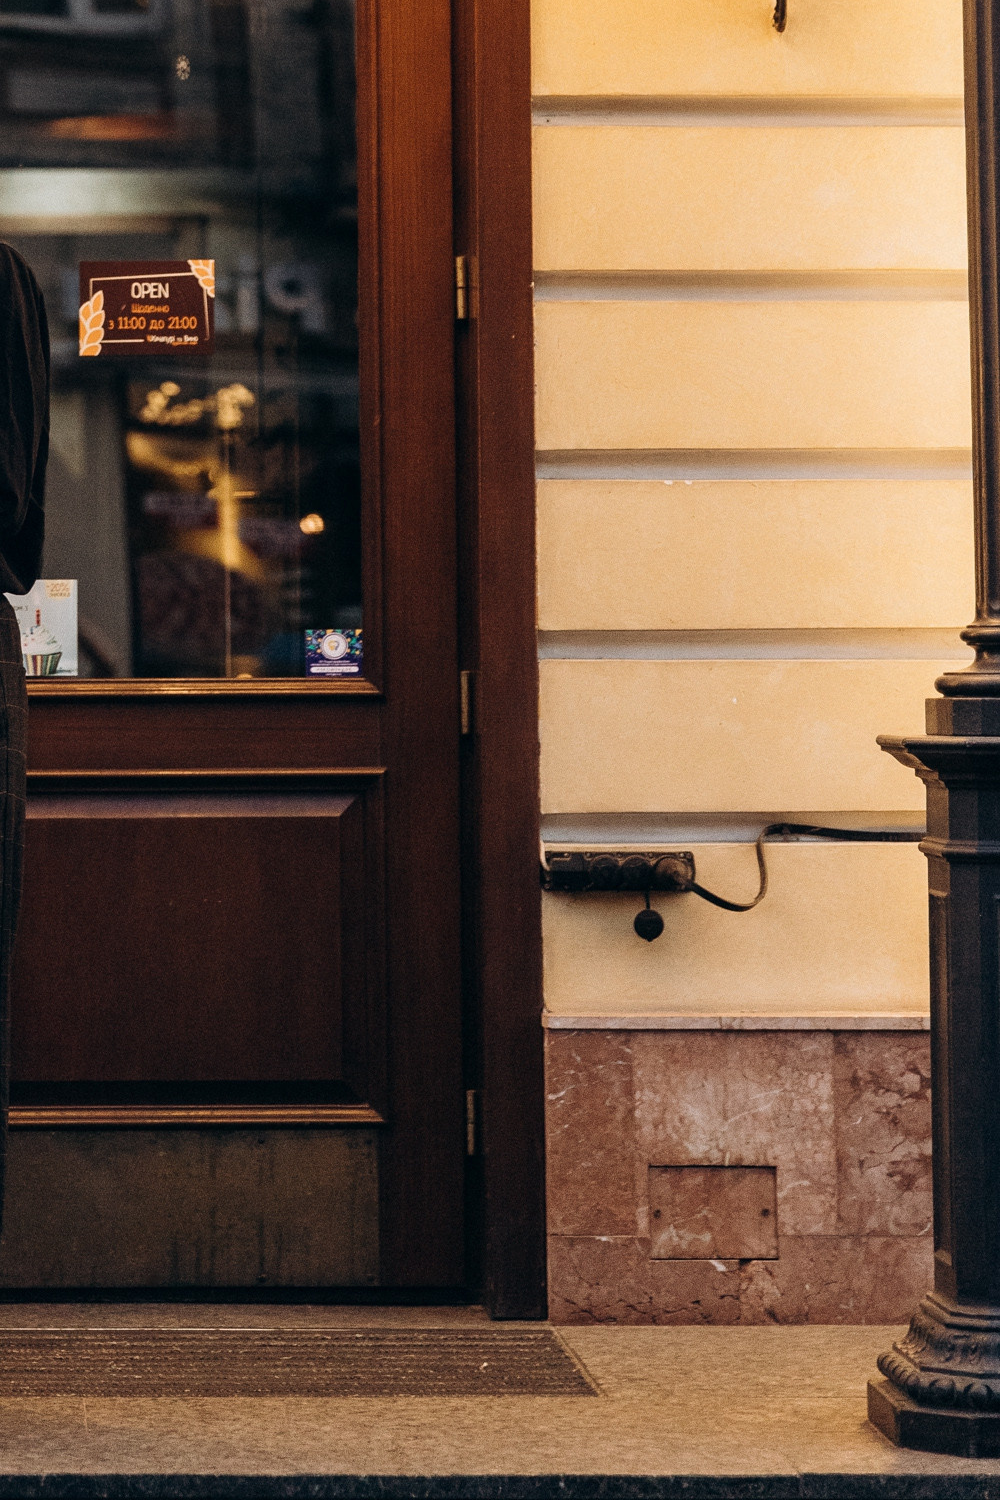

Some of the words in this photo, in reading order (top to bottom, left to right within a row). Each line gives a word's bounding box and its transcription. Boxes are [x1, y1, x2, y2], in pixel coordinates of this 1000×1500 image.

[130, 282, 170, 299] OPEN
[131, 303, 170, 314] Щоденно
[118, 316, 146, 330] 11:00
[149, 320, 165, 331] до
[168, 316, 198, 330] 21:00
